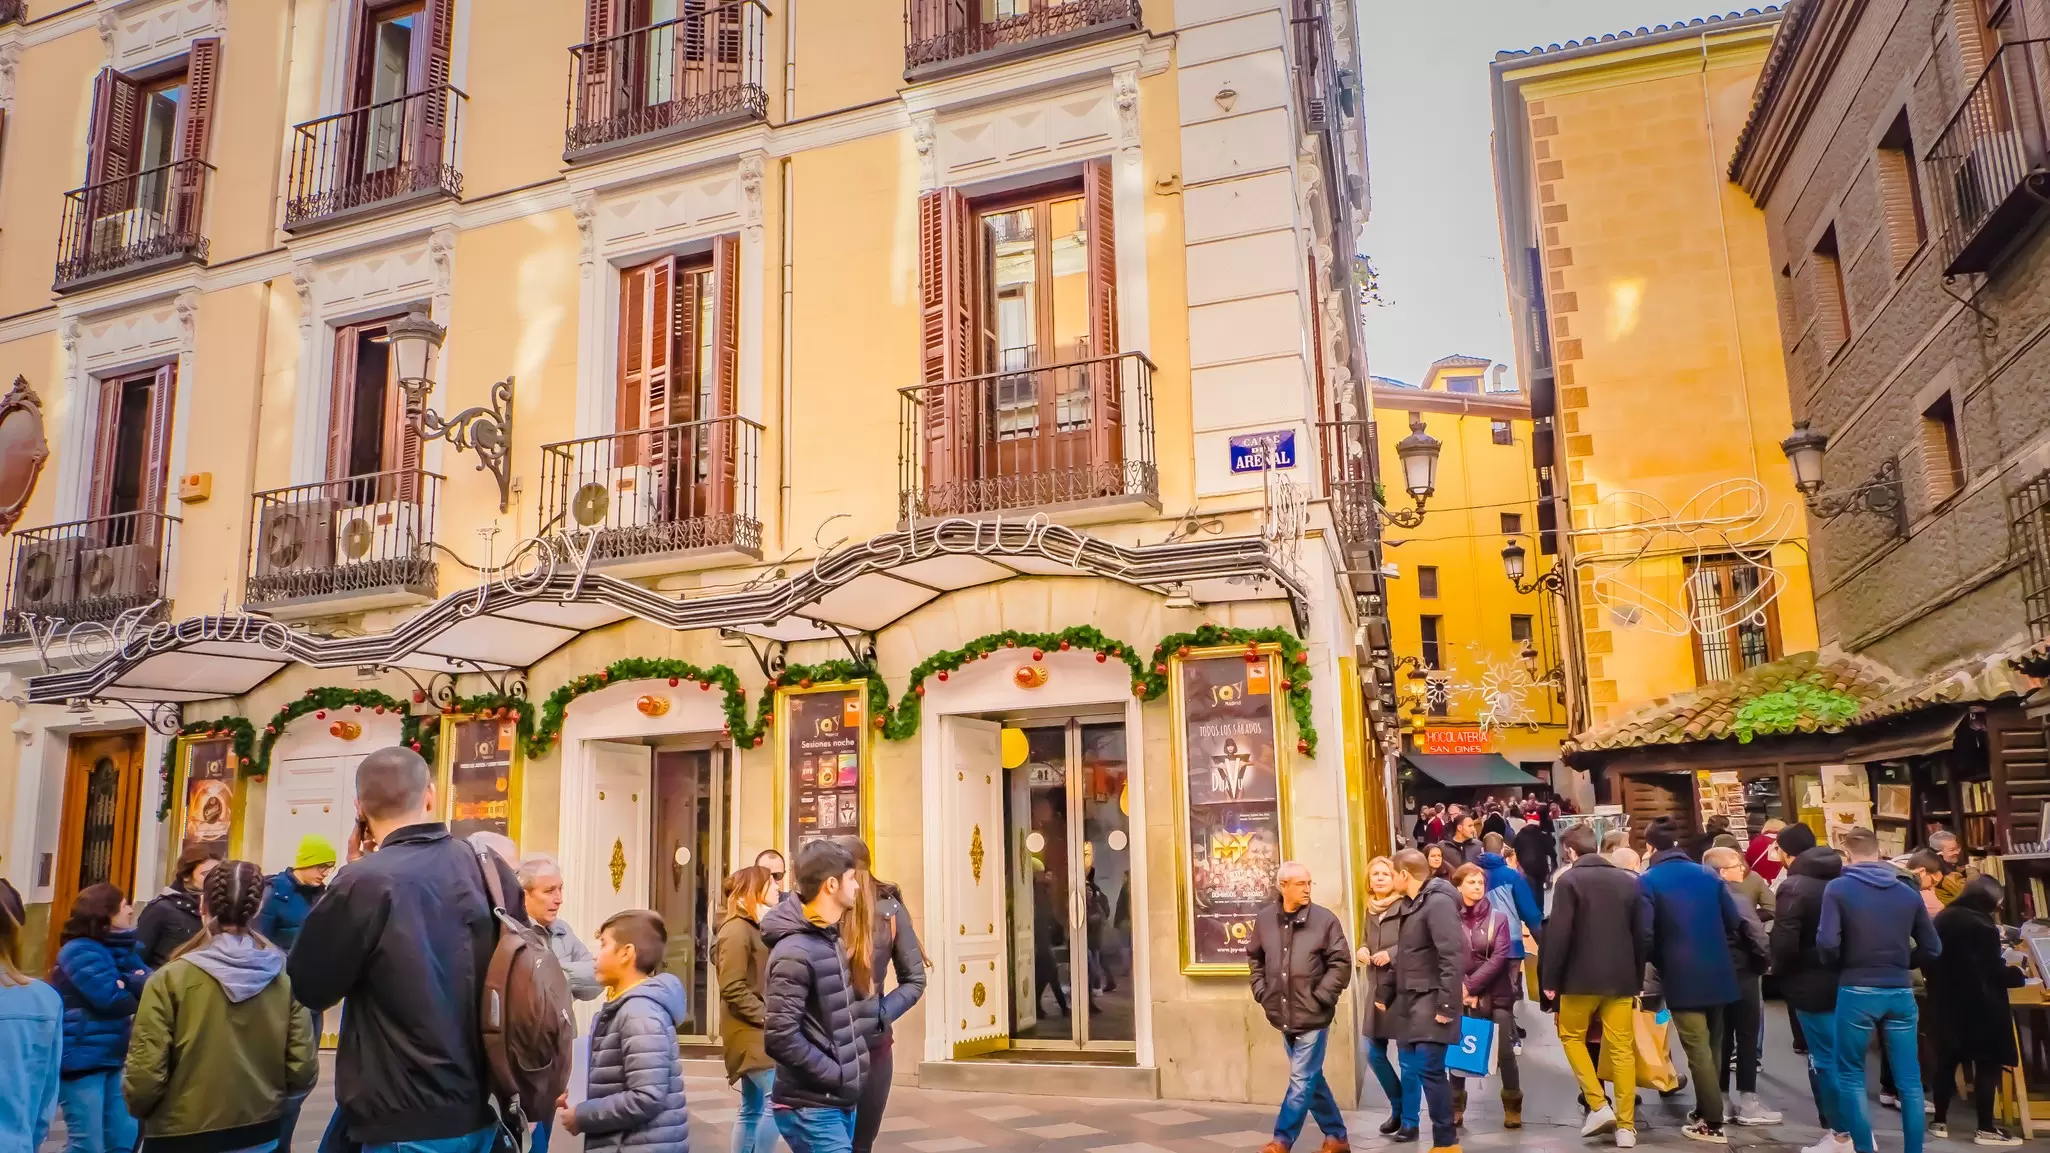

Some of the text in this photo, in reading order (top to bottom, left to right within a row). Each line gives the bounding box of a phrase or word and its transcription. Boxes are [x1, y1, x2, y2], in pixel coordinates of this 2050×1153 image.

[813, 493, 1094, 586] Eslava
[1200, 725, 1219, 737] TODOS
[1220, 724, 1232, 736] LOS
[801, 737, 855, 749] Sesiones noche
[1430, 745, 1482, 753] SAN GINES
[1461, 1035, 1478, 1054] S
